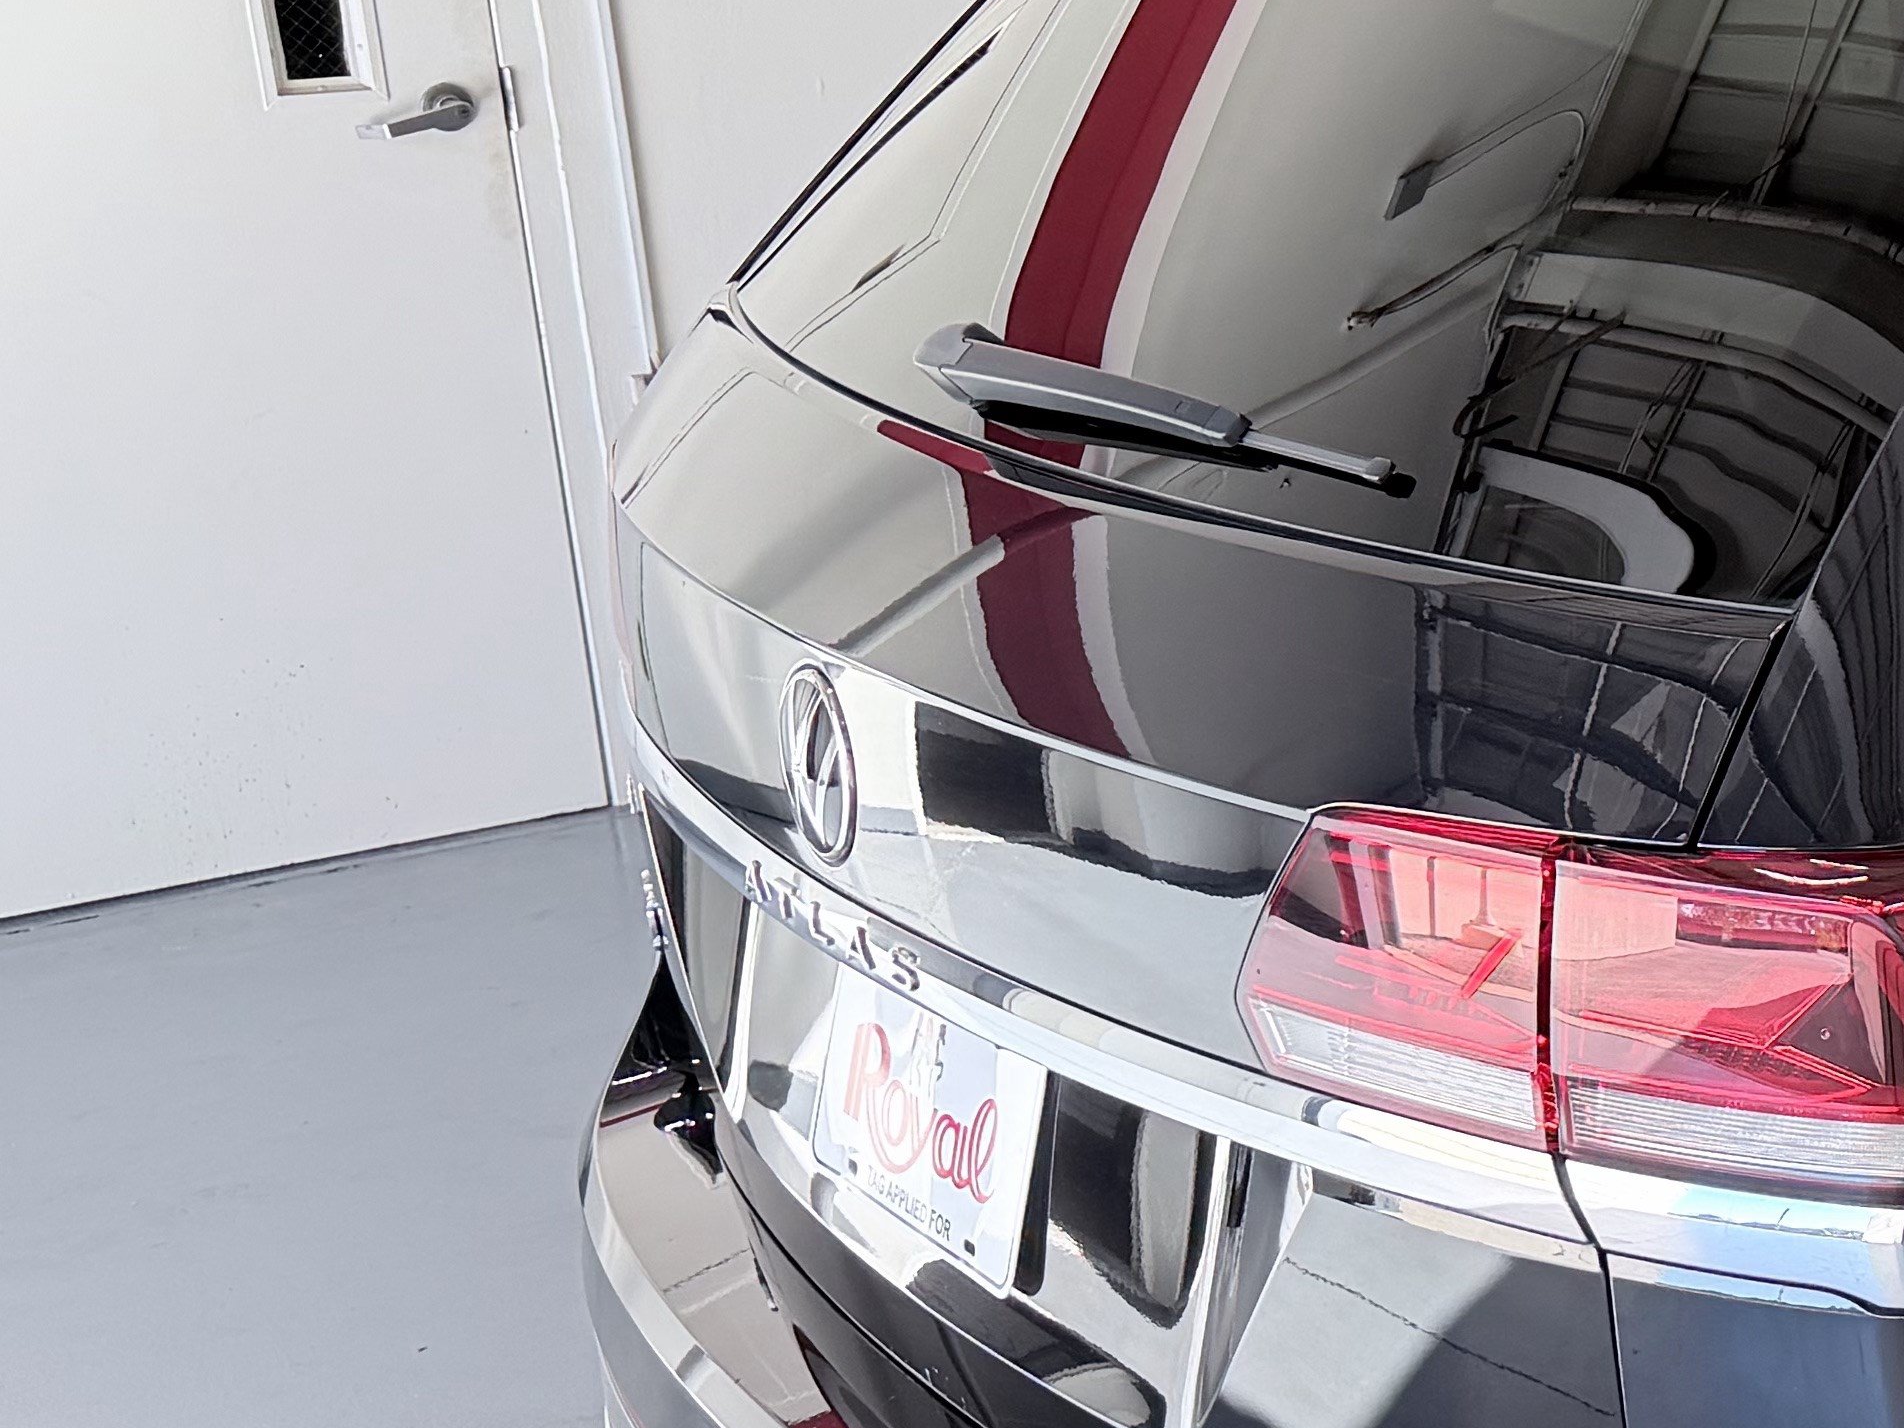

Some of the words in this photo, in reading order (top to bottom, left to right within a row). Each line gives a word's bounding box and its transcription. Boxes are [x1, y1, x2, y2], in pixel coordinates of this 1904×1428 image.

[745, 860, 921, 991] ATLAS
[844, 1022, 999, 1204] Royal
[867, 1165, 884, 1195] TAG
[883, 1180, 928, 1224] APPLIED
[928, 1209, 951, 1242] FOR
